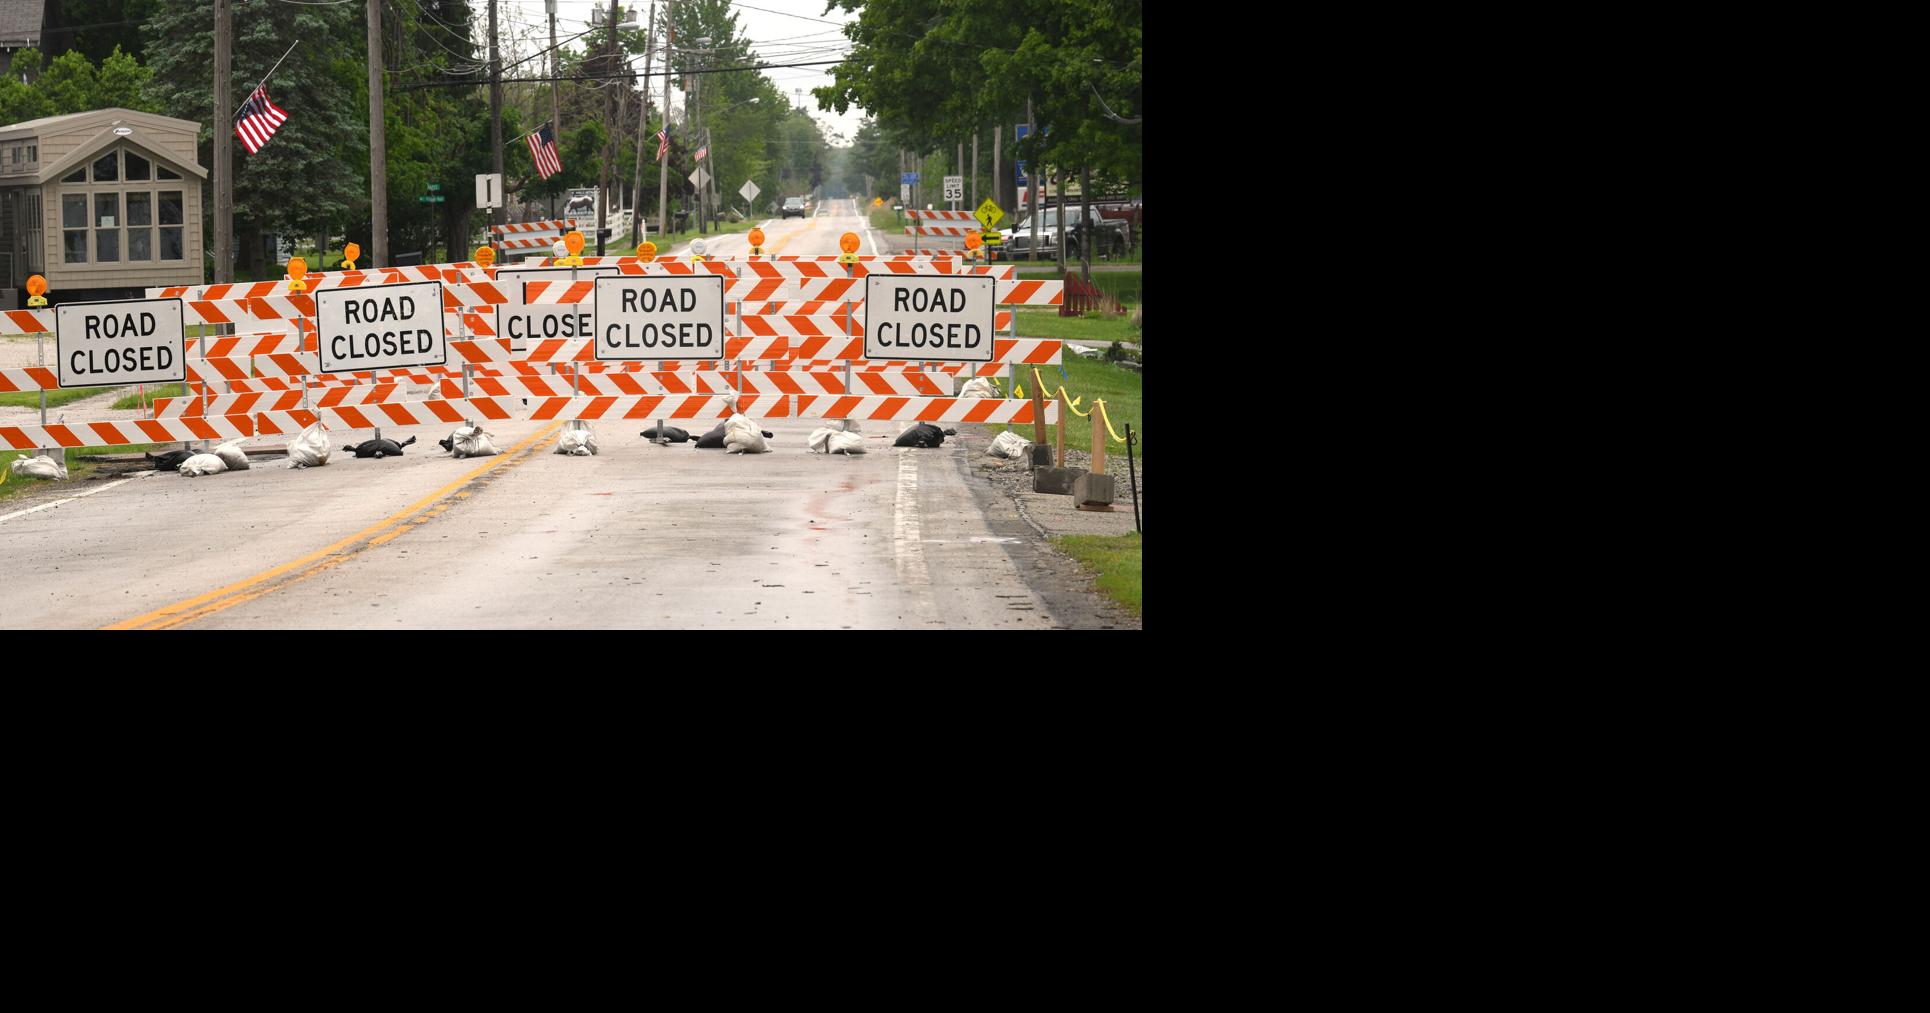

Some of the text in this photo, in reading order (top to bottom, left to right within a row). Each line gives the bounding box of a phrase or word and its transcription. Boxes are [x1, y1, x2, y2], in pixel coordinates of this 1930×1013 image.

[945, 188, 962, 199] 35
[345, 296, 414, 324] ROAD
[623, 288, 696, 312] ROAD
[895, 288, 966, 312] ROAD
[86, 313, 155, 339] ROAD
[508, 314, 593, 339] CLOSE
[606, 323, 713, 348] CLOSED
[878, 322, 981, 348] CLOSED
[332, 330, 432, 359] CLOSED
[71, 346, 172, 374] CLOSED
